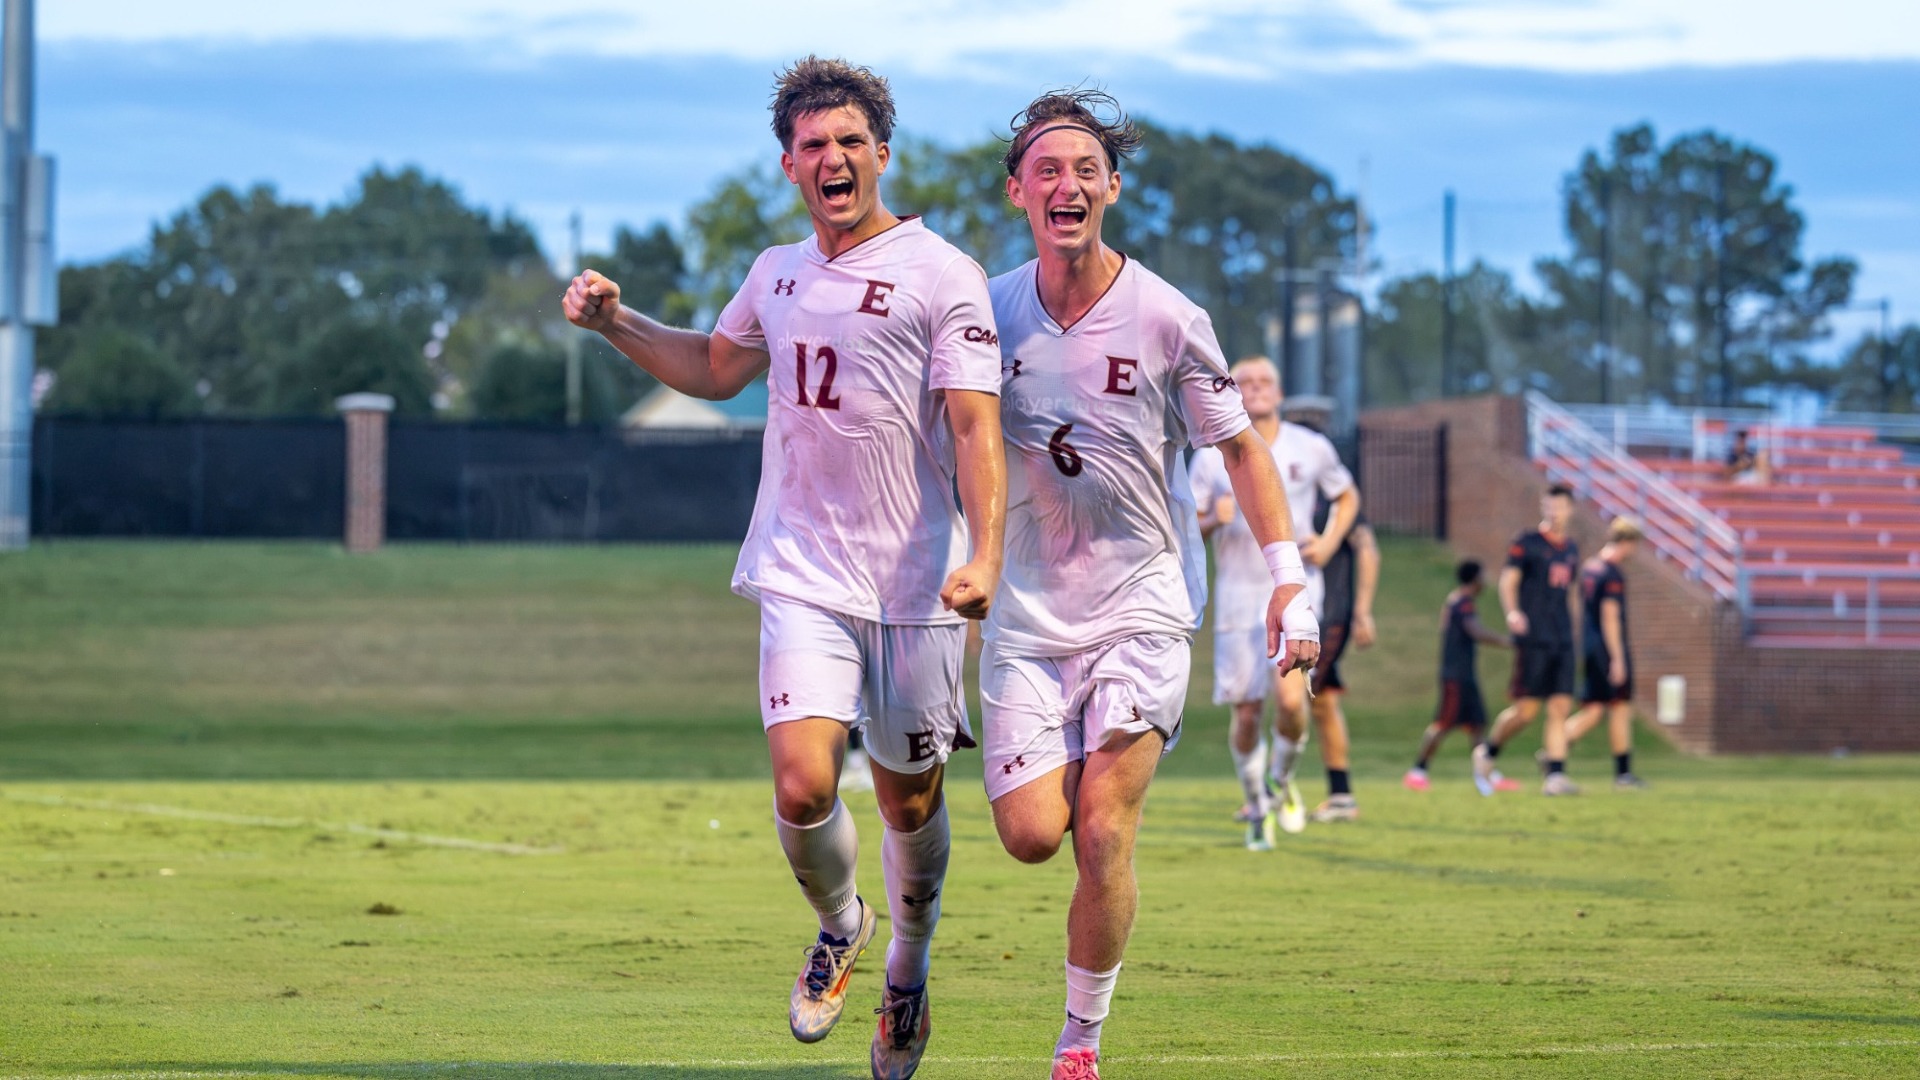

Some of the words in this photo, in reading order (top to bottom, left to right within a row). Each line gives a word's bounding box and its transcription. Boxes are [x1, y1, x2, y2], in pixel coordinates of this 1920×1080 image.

[856, 279, 895, 318] E
[794, 341, 842, 411] 12
[1102, 355, 1138, 397] E
[1049, 423, 1082, 477] 6
[904, 730, 936, 762] E
